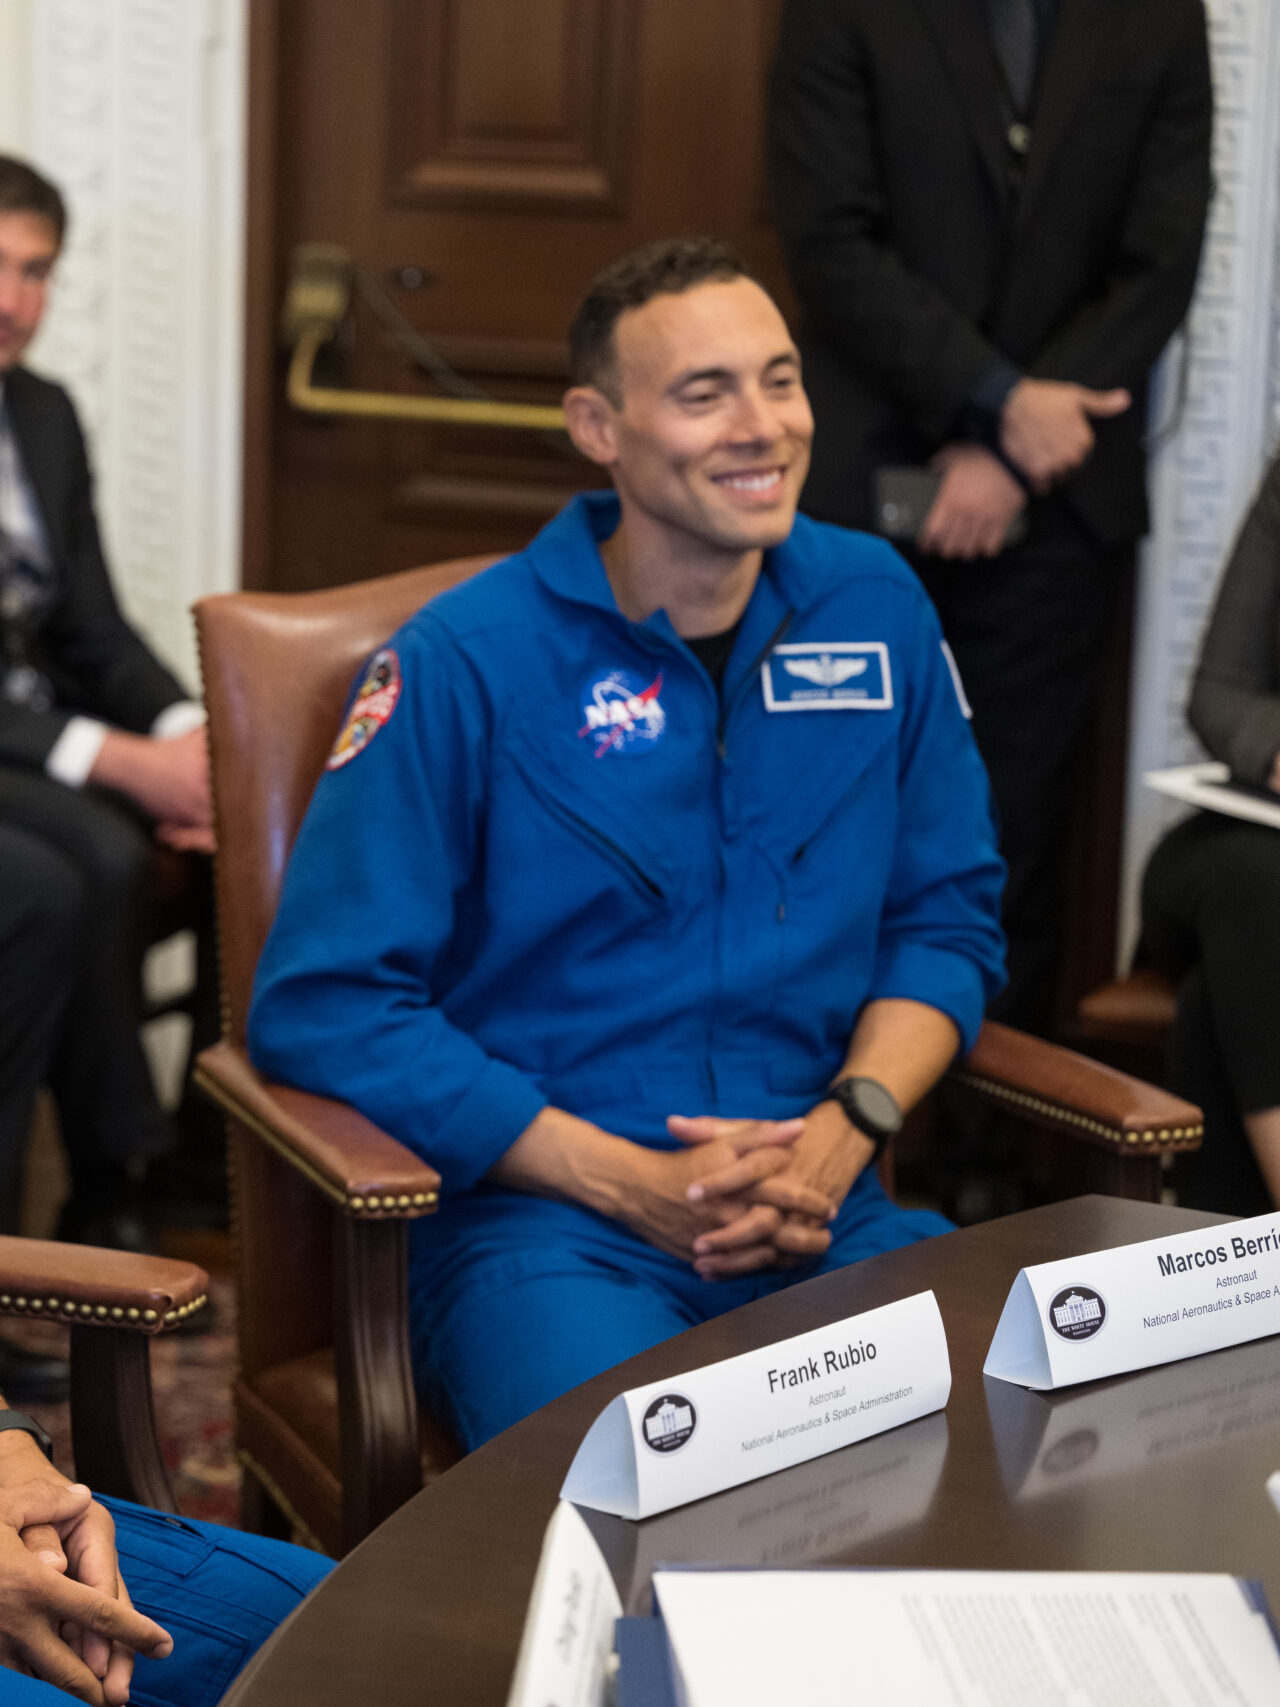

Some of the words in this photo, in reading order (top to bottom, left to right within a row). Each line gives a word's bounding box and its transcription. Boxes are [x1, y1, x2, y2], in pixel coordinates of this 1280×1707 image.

[584, 697, 665, 730] NASA
[1157, 1246, 1228, 1276] Marcos
[1231, 1228, 1280, 1259] Berrí
[1216, 1269, 1258, 1288] Astronaut
[1143, 1310, 1180, 1328] National
[1182, 1298, 1233, 1319] Aeronautics
[1235, 1295, 1242, 1306] &
[1243, 1289, 1271, 1304] Space
[1273, 1285, 1280, 1297] A
[767, 1358, 820, 1393] Frank
[824, 1341, 877, 1374] Rubio
[809, 1386, 847, 1407] Astronaut
[741, 1431, 775, 1452] National
[776, 1415, 823, 1441] Aeronautics
[824, 1412, 831, 1424] &
[832, 1404, 857, 1422] Space
[859, 1386, 913, 1412] Administration
